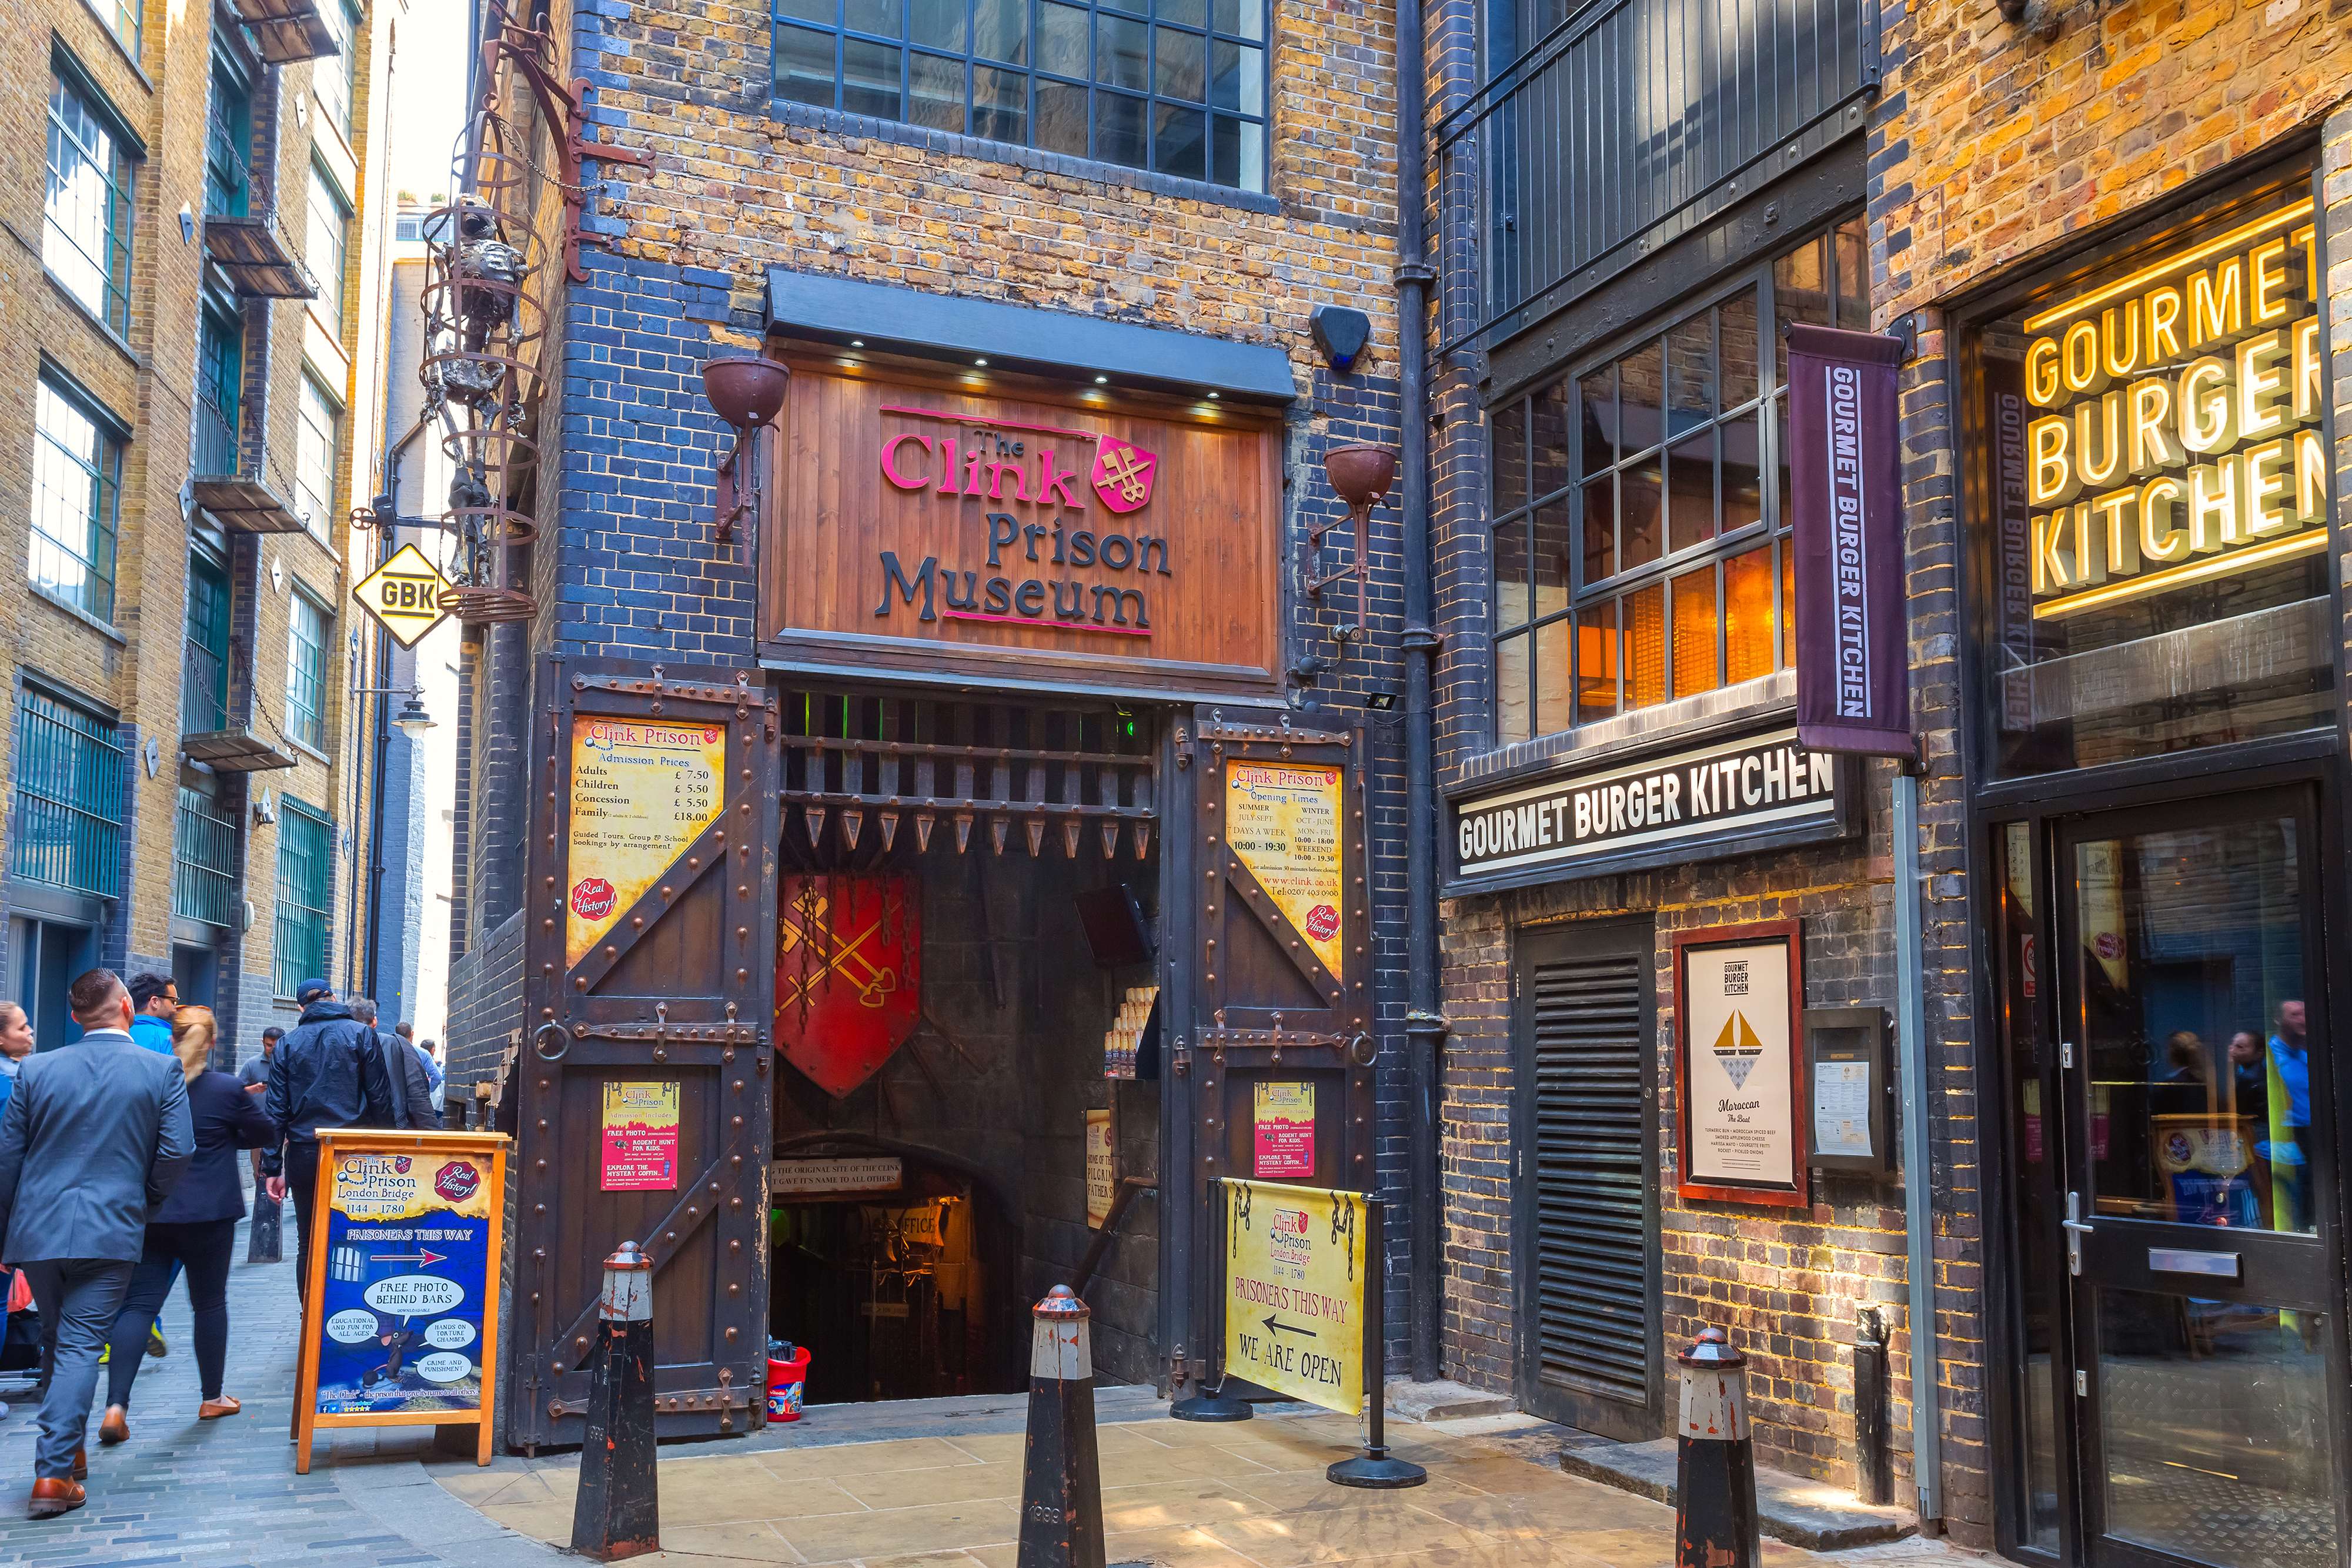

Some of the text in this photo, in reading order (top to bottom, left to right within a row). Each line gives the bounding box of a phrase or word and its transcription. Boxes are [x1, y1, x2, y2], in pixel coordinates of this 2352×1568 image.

[2024, 223, 2317, 407] GOURMET
[974, 429, 1024, 456] The
[881, 433, 1085, 509] Clink
[2030, 428, 2327, 595] KITCHEN
[985, 513, 1171, 576] Prison
[1833, 368, 1863, 718] GOURMET BURGER KITCHEN
[382, 581, 435, 609] GBK
[875, 551, 1149, 626] Museum
[591, 726, 701, 745] Clink Prison
[599, 753, 690, 767] Admission Prices
[576, 766, 709, 780] Adults 7.50
[1237, 770, 1273, 783] Clink
[1279, 771, 1322, 786] Prison
[576, 779, 708, 793] Children 5.50
[575, 793, 707, 808] Concession 5.50
[1251, 791, 1318, 804] Opening Times
[1459, 745, 1833, 860] GOURMET BURGER KITCHEN
[575, 807, 608, 819] Family
[674, 812, 707, 821] £18.00
[573, 839, 607, 848] bookings
[1234, 841, 1285, 851] 10:00 19:30
[1264, 877, 1338, 887] www.clink.co.uk
[570, 892, 615, 917] History!
[1304, 918, 1341, 939] History!
[1725, 964, 1748, 972] GOURMET
[1725, 972, 1748, 983] BURGER
[1725, 983, 1748, 993] KITCHEN
[1718, 1099, 1759, 1112] Moroccan
[1728, 1114, 1736, 1122] The
[1088, 1154, 1098, 1164] HOME
[345, 1160, 393, 1174] Clink
[369, 1175, 416, 1188] Prison
[435, 1176, 477, 1196] History!
[338, 1185, 414, 1201] London Bridge
[1088, 1184, 1112, 1199] FATHERS
[346, 1205, 405, 1213] 1144 1780
[1274, 1213, 1298, 1233] Clink
[347, 1229, 473, 1241] PRISONERS THIS WAY
[1284, 1233, 1311, 1251] Prison
[1270, 1242, 1310, 1266] London Bridge
[1274, 1265, 1305, 1280] 1144 1780
[380, 1283, 448, 1292] FREE PHOTO
[376, 1295, 452, 1304] BEHIND BARS
[1235, 1276, 1348, 1324] PRISONERS THIS WAY
[1239, 1333, 1342, 1388] WE ARE OPEN
[375, 1386, 479, 1400] prison others!
